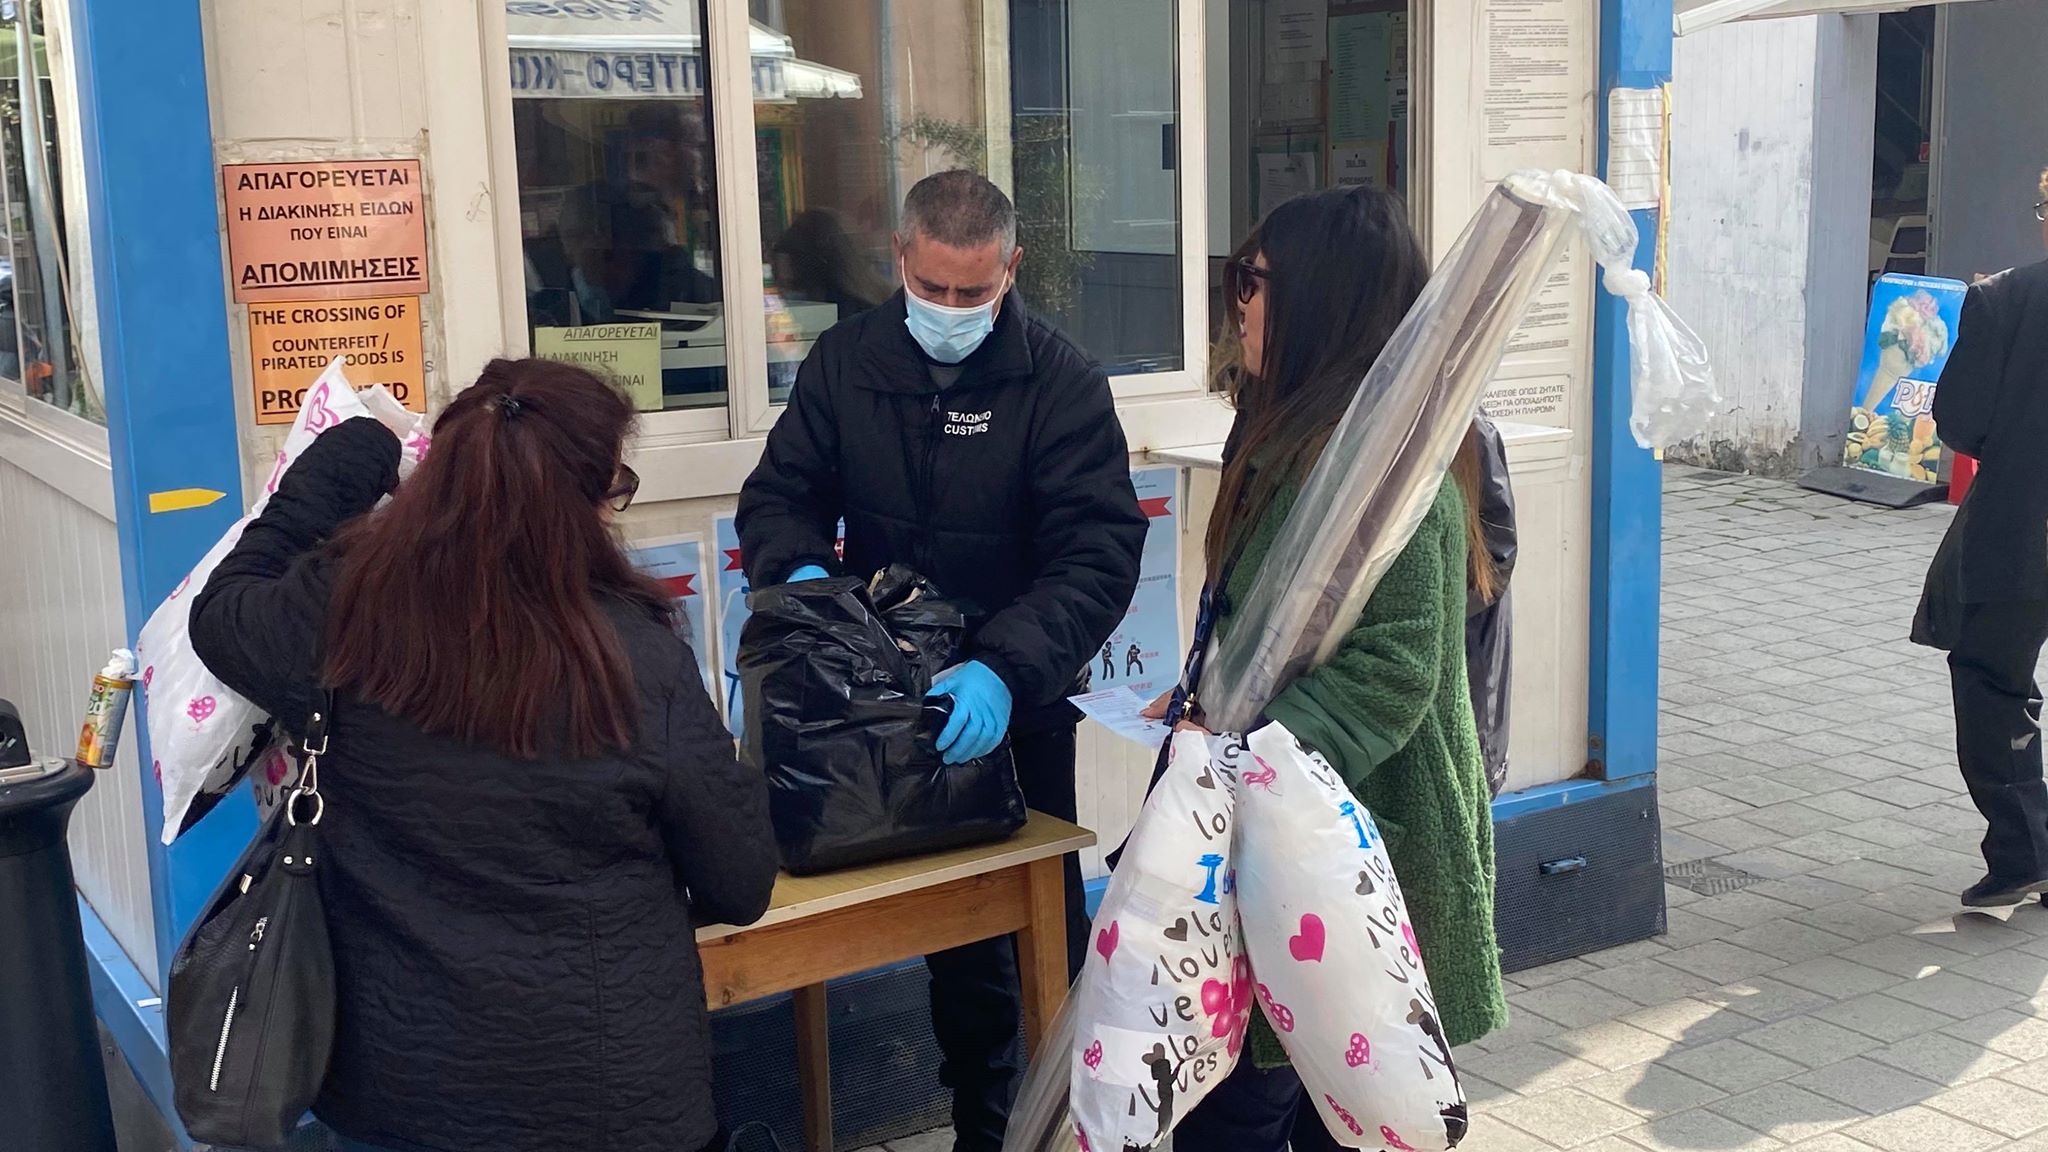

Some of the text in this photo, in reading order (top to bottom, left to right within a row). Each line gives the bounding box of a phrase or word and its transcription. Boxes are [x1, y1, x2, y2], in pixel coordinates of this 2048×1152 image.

[238, 169, 409, 190] ΑΠΑΓΟΡΕΥΕΤΑΙ
[239, 201, 414, 221] Η ΔΙΑΚΙΝΗΣΗ ΕΙΔΩΝ
[290, 225, 368, 241] ΠΟΥ ΕΙΝΑΙ
[241, 256, 421, 285] ΑΠΟΜΙΜΗΣΕΙΣ
[251, 304, 406, 325] THE CROSSING OF
[563, 326, 658, 339] ΑΠΑΓΟΡΕΥΕΤΑΙ
[272, 334, 379, 353] COUNTERFEIT
[261, 350, 405, 371] PIRATED OODS IS
